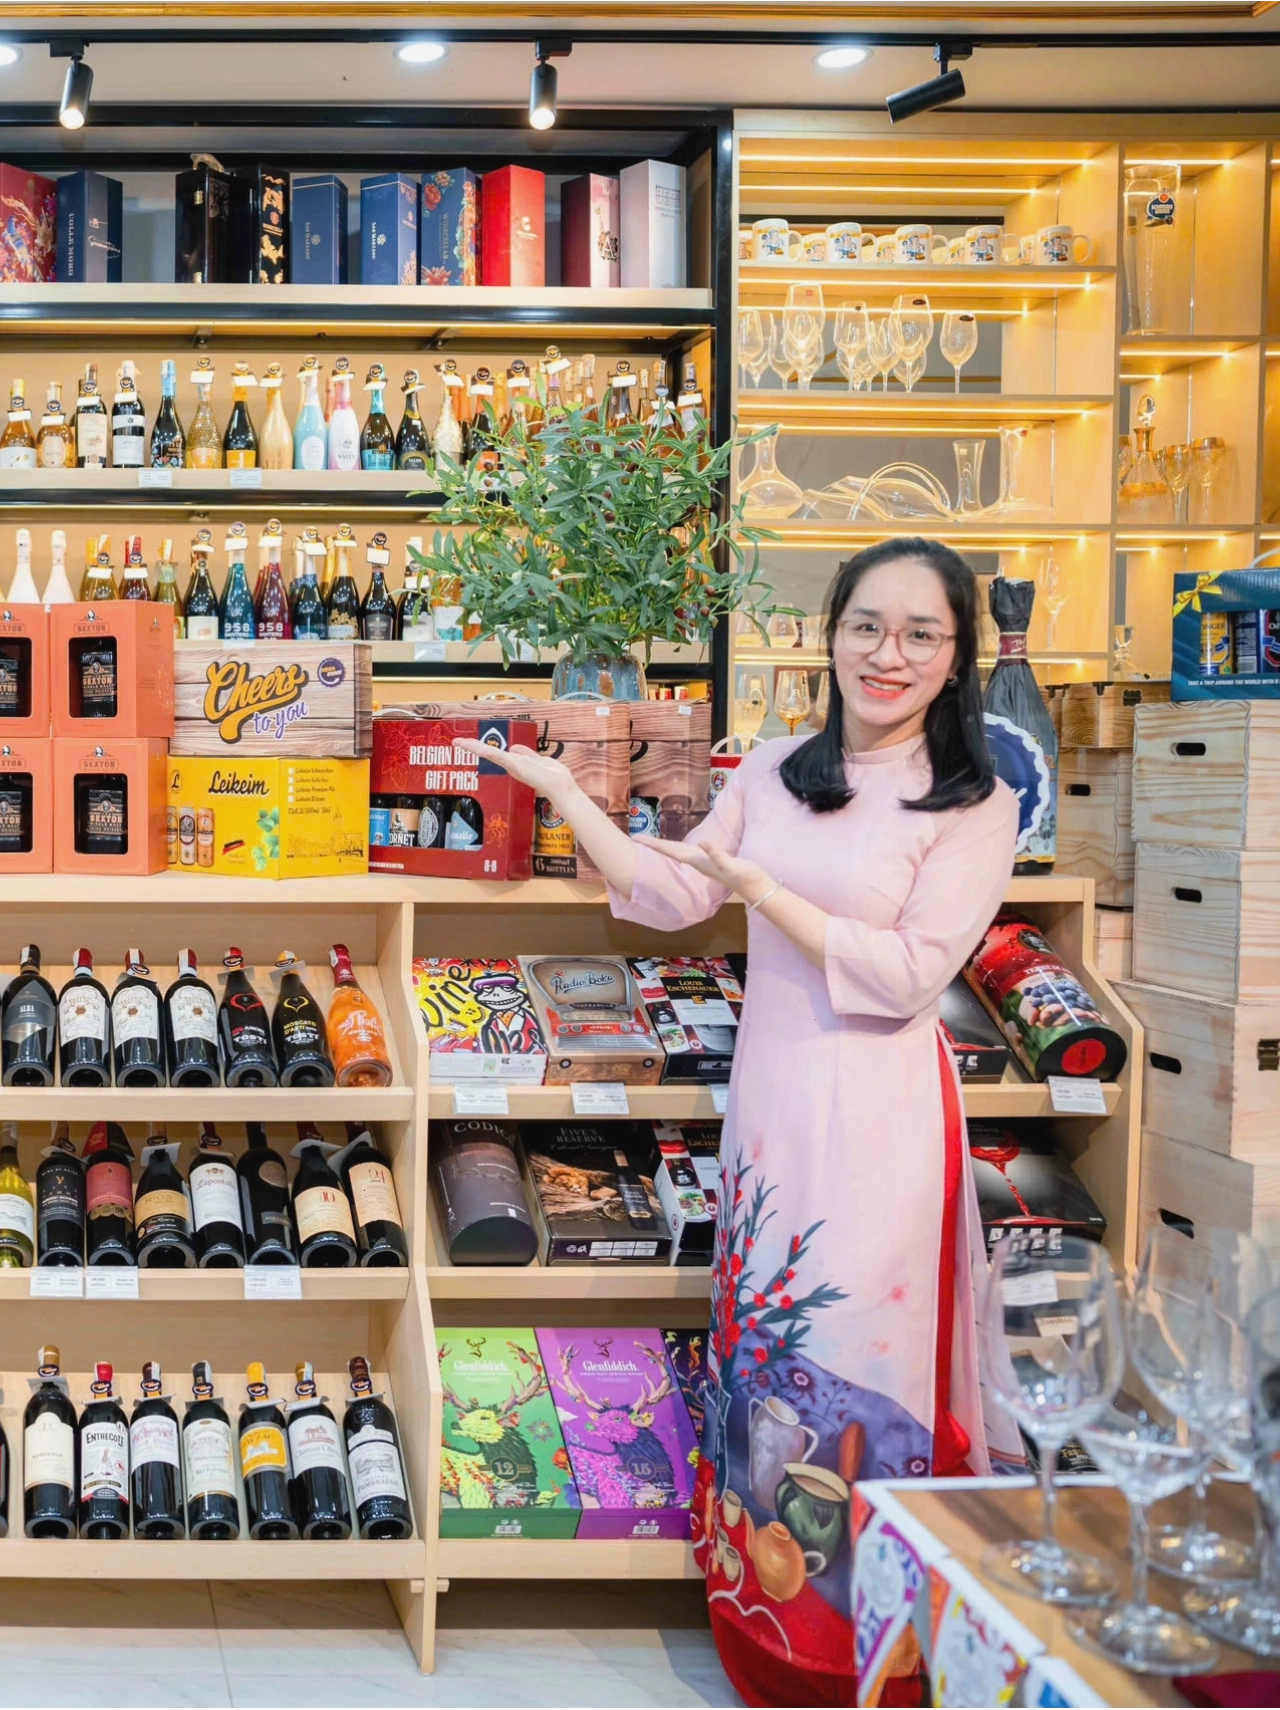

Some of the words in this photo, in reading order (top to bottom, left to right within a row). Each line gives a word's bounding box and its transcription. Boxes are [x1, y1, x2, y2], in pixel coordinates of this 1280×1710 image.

[77, 624, 106, 632] SEXTON
[224, 623, 250, 632] 958
[258, 623, 284, 632] 958
[83, 677, 112, 685] SEXTON
[204, 661, 309, 742] Cheers
[253, 712, 270, 735] to
[274, 701, 309, 739] you
[409, 746, 452, 765] BELGIAN
[83, 760, 116, 768] SEXTON
[208, 770, 269, 796] Leikeim
[425, 771, 447, 790] GIFT
[449, 771, 479, 790] PACK
[89, 815, 123, 823] SEXTON
[451, 831, 473, 840] malle
[538, 833, 571, 841] ULANER
[535, 858, 545, 872] 6
[546, 865, 575, 873] BOTTLES
[551, 976, 586, 994] Radio
[587, 972, 617, 987] Boka
[19, 1004, 34, 1013] ALBA
[283, 1020, 317, 1030] MOSCATO
[284, 1026, 305, 1035] D'ASTI
[234, 1034, 267, 1044] TOSTI
[284, 1033, 320, 1043] TOSTI
[453, 1120, 511, 1138] CODIC
[560, 1127, 598, 1136] FIVE'S
[556, 1135, 606, 1143] RESERVE
[702, 1132, 720, 1140] LOU
[688, 1139, 720, 1147] ESCHE
[453, 1359, 508, 1371] Glenfiddich
[582, 1359, 637, 1371] Glenfiddich
[495, 1462, 515, 1475] 12
[631, 1463, 652, 1475] 15
